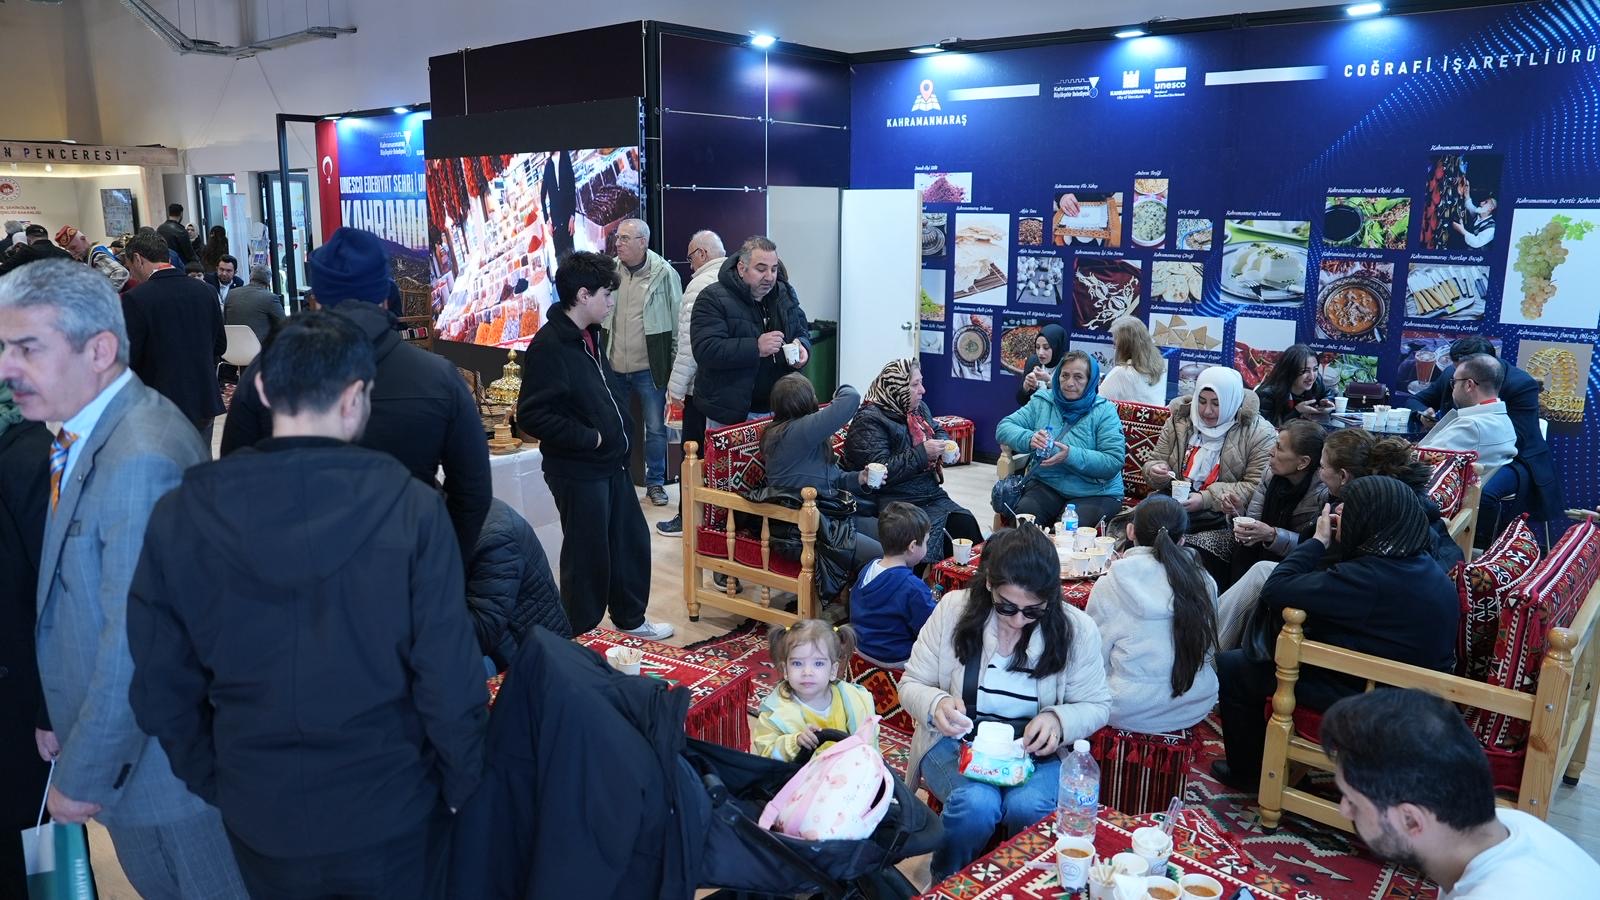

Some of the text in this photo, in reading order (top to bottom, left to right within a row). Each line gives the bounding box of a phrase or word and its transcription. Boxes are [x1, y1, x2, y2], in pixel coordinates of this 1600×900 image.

[1344, 56, 1432, 78] COĞRAFİ
[1443, 48, 1550, 74] İŞARETLİ
[1154, 82, 1186, 90] unesco
[886, 114, 968, 128] KAHRAMANMARAŞ
[340, 176, 364, 193] UNESCO
